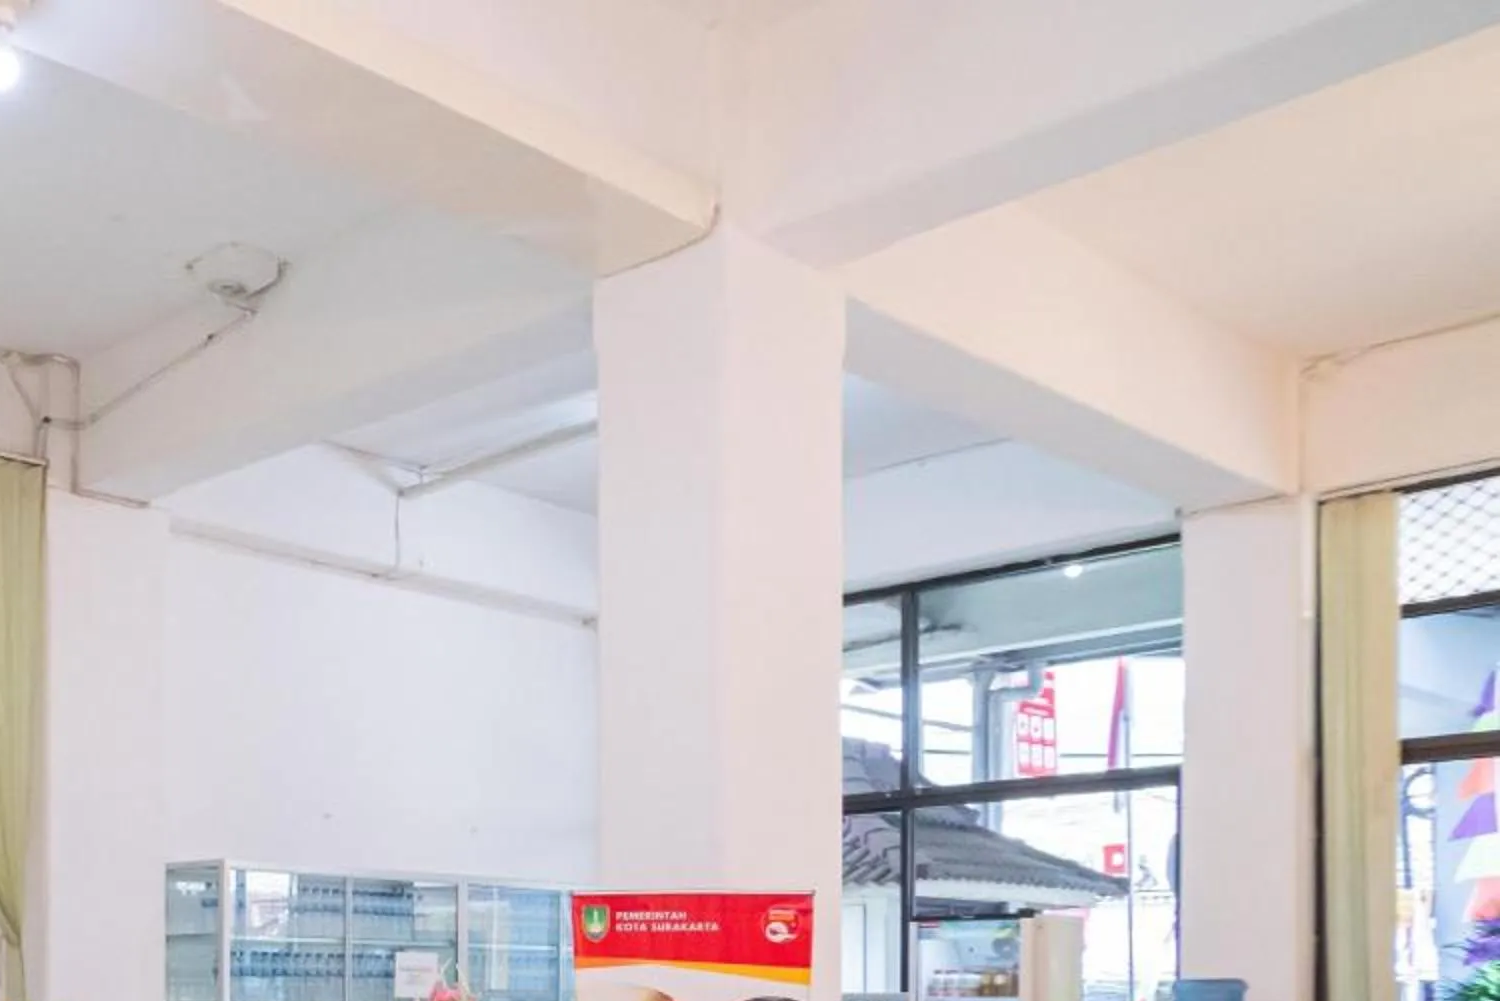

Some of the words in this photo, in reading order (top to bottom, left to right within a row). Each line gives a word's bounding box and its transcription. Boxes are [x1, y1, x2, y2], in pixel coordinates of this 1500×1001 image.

[615, 911, 687, 920] PEMERINTAH
[615, 922, 647, 932] KOTA
[650, 922, 719, 932] SURAKARTA
